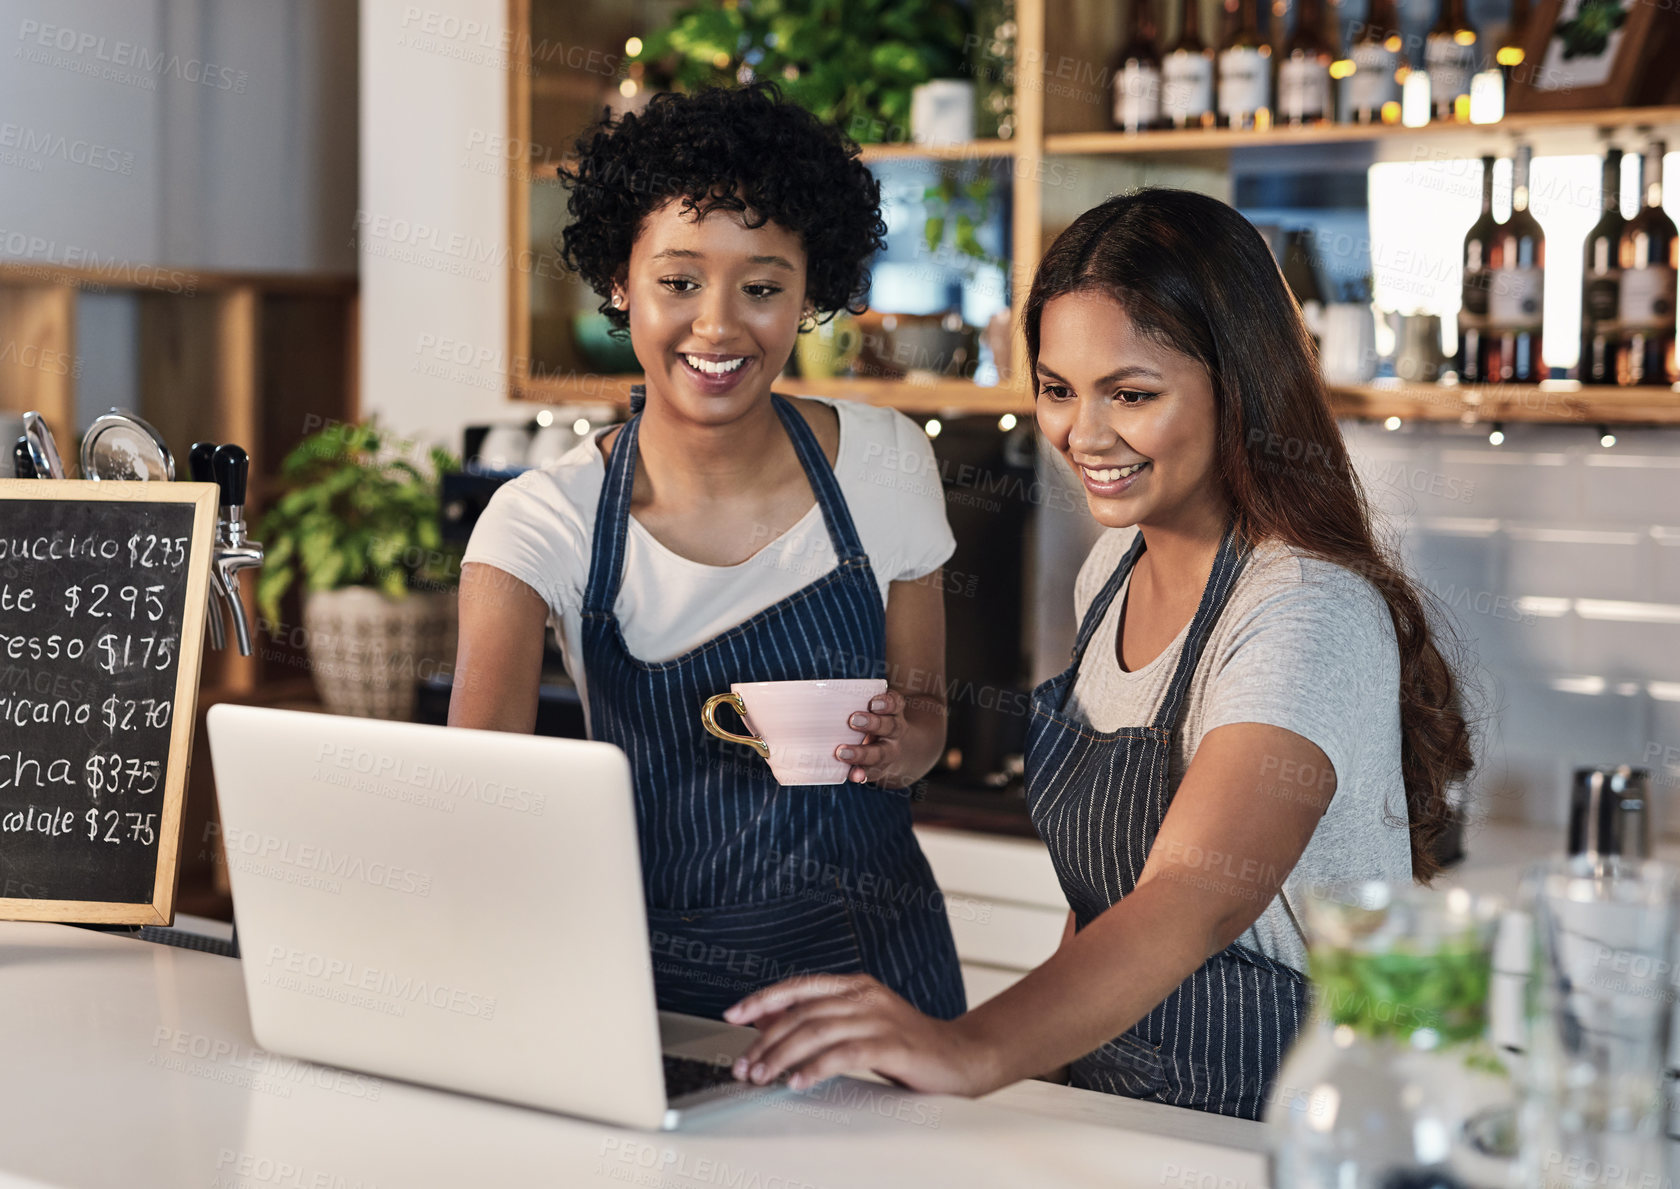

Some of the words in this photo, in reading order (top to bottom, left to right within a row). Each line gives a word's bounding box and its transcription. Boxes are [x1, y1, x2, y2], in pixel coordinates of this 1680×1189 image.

[127, 533, 189, 569] $2.75
[1, 584, 36, 612] te
[64, 584, 165, 621] $2.95
[0, 633, 84, 660] esso
[97, 633, 176, 675] $1.75
[0, 690, 90, 726] icano
[102, 693, 171, 737] $2.70
[85, 754, 161, 798] $3.75
[2, 806, 75, 837] colate
[85, 808, 157, 846] $2.75
